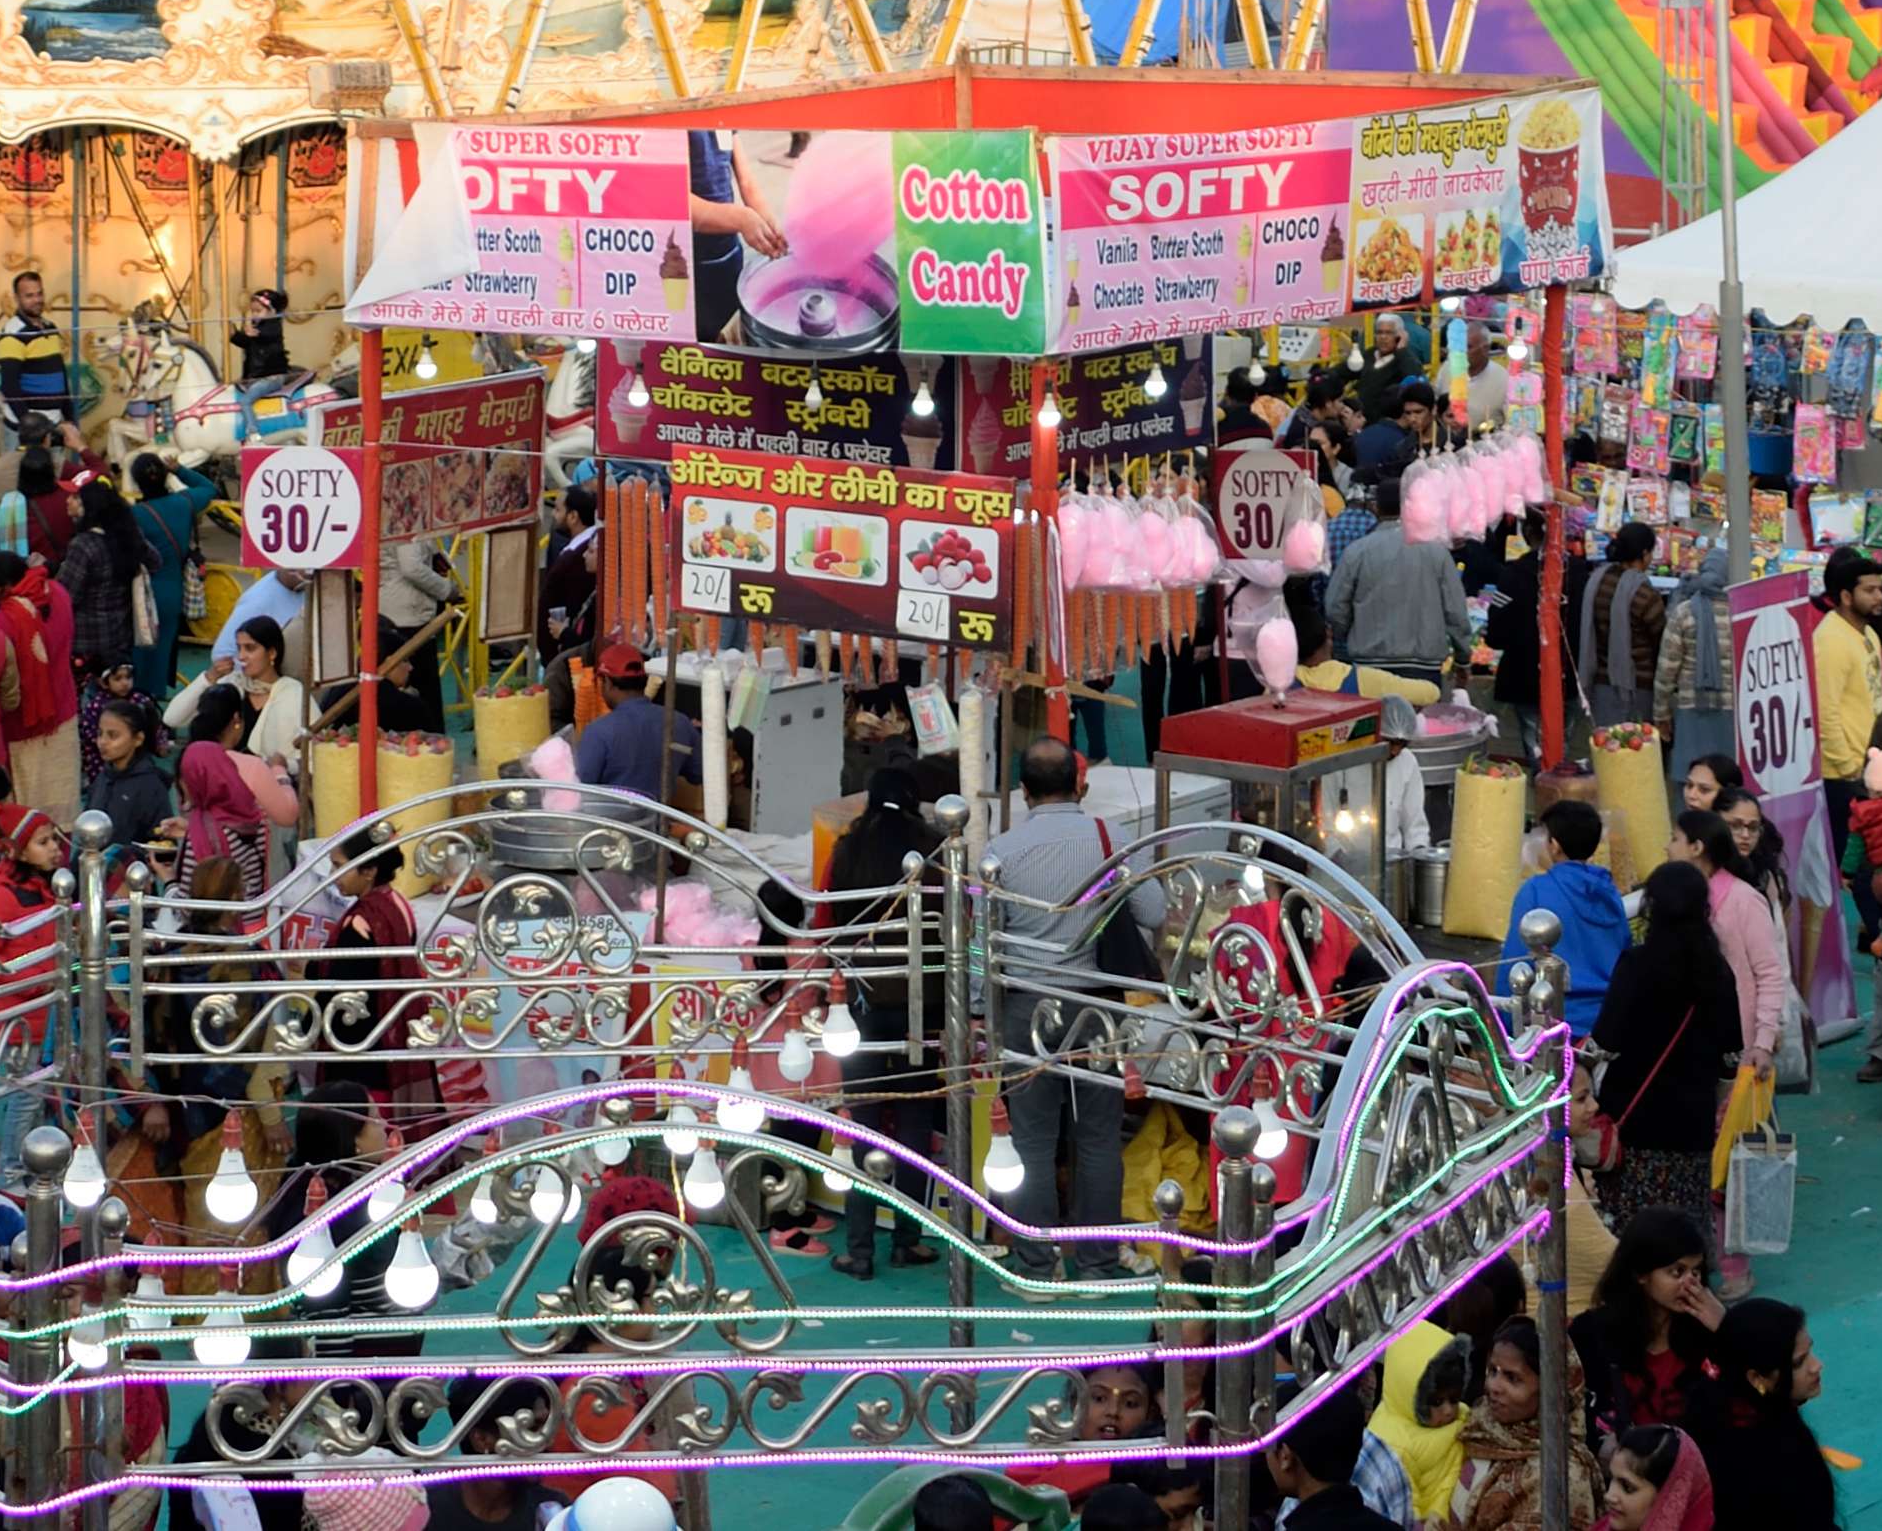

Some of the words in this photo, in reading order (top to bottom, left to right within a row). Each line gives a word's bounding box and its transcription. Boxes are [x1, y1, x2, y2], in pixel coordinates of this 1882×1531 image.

[470, 131, 552, 155] SUPER
[559, 133, 643, 157] SOFTY
[1087, 137, 1157, 164] VIJAY
[1164, 132, 1239, 159] SUPER
[1244, 124, 1317, 151] SOFTY
[1396, 112, 1418, 156] की
[466, 166, 618, 213] OFTY
[902, 163, 1029, 223] Cotton
[1105, 161, 1294, 222] SOFTY
[1443, 165, 1506, 196] जायकेदार
[475, 229, 500, 253] tter
[505, 228, 542, 254] Scoth
[585, 228, 655, 253] CHOCO
[1262, 216, 1320, 244] CHOCO
[1096, 238, 1138, 266] Vanila
[1150, 234, 1189, 262] Butter
[1191, 231, 1225, 256] Scoth
[465, 271, 538, 300] Strawberry
[605, 272, 638, 296] DIP
[909, 248, 1028, 320] Candy
[1275, 261, 1303, 287] DIP
[1520, 253, 1551, 286] पॉप
[1094, 282, 1144, 310] Choclate
[1155, 277, 1219, 305] Strawberry
[372, 300, 424, 320] आपके
[434, 301, 463, 323] मेले
[471, 301, 490, 325] में
[496, 305, 543, 328] पहली
[551, 310, 584, 329] बार
[593, 311, 606, 330] 6
[613, 310, 670, 333] फ्लेवर
[1072, 324, 1123, 350] आपके
[1128, 317, 1160, 344] मेले
[1237, 309, 1267, 330] बार
[1272, 305, 1283, 326] 6
[1290, 298, 1339, 322] फ्लेवर
[660, 344, 744, 381] वैनिला
[761, 362, 815, 387] बटर
[820, 365, 895, 395] स्कॉच
[651, 382, 753, 417] चॉकलेट
[657, 422, 703, 443] आपके
[706, 423, 735, 449] मेले
[738, 426, 755, 449] में
[757, 430, 798, 455] पहली
[802, 437, 828, 457] बार
[831, 441, 840, 458] 6
[261, 468, 344, 498] SOFTY
[671, 451, 764, 491] ऑरेन्ज
[771, 460, 824, 498] और
[831, 466, 899, 505] लीची
[905, 486, 947, 512] का
[953, 488, 1014, 526] जूस
[1232, 470, 1299, 497] SOFTY
[261, 503, 348, 555] 30/-
[1234, 502, 1285, 549] 30/
[1747, 639, 1802, 692] SOFTY
[1749, 691, 1812, 774] 30/-
